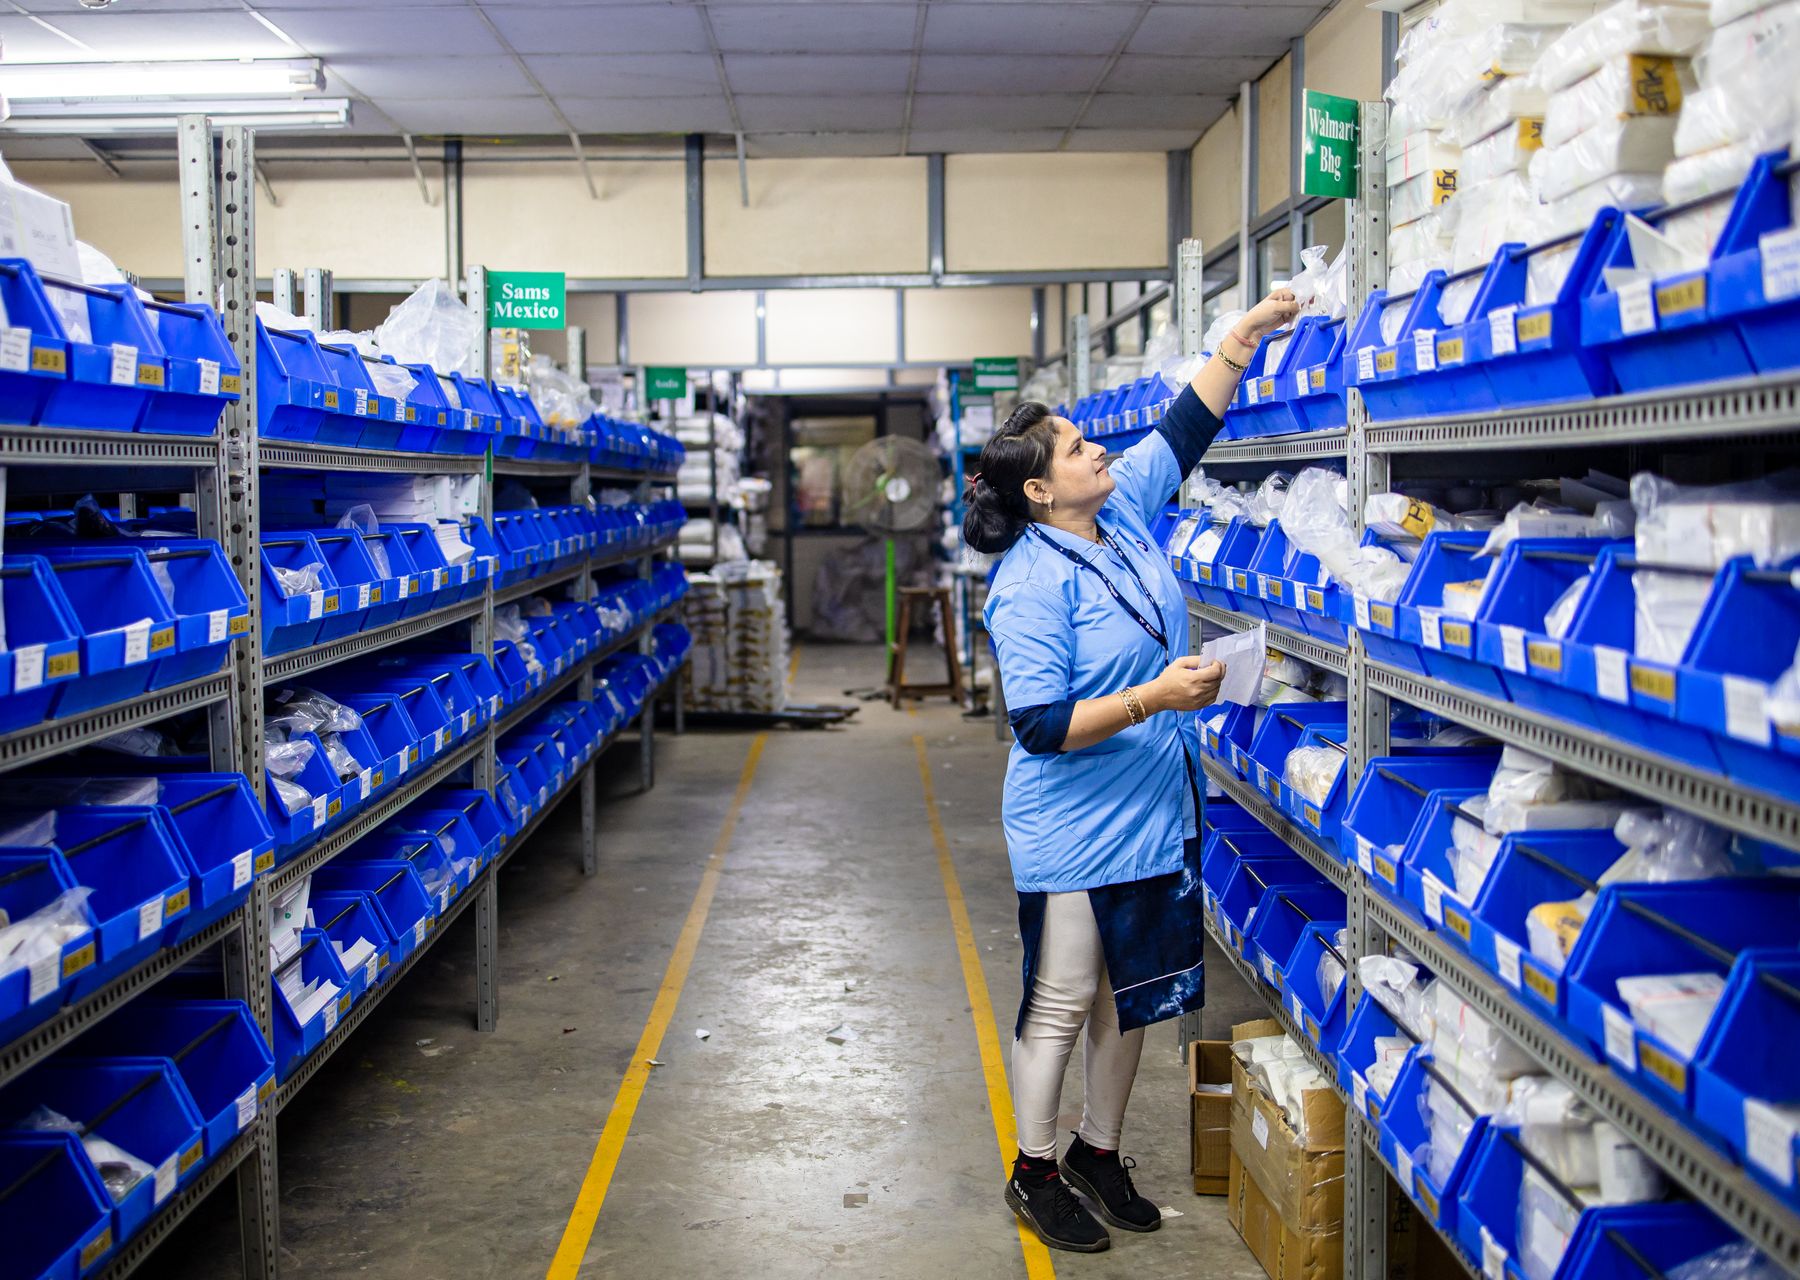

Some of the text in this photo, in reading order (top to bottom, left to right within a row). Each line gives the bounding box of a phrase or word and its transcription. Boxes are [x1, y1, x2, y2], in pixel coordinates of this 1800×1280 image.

[1309, 107, 1355, 142] Walmart
[1320, 145, 1341, 182] Bhg
[502, 283, 550, 300] Sams
[494, 301, 559, 319] Mexico
